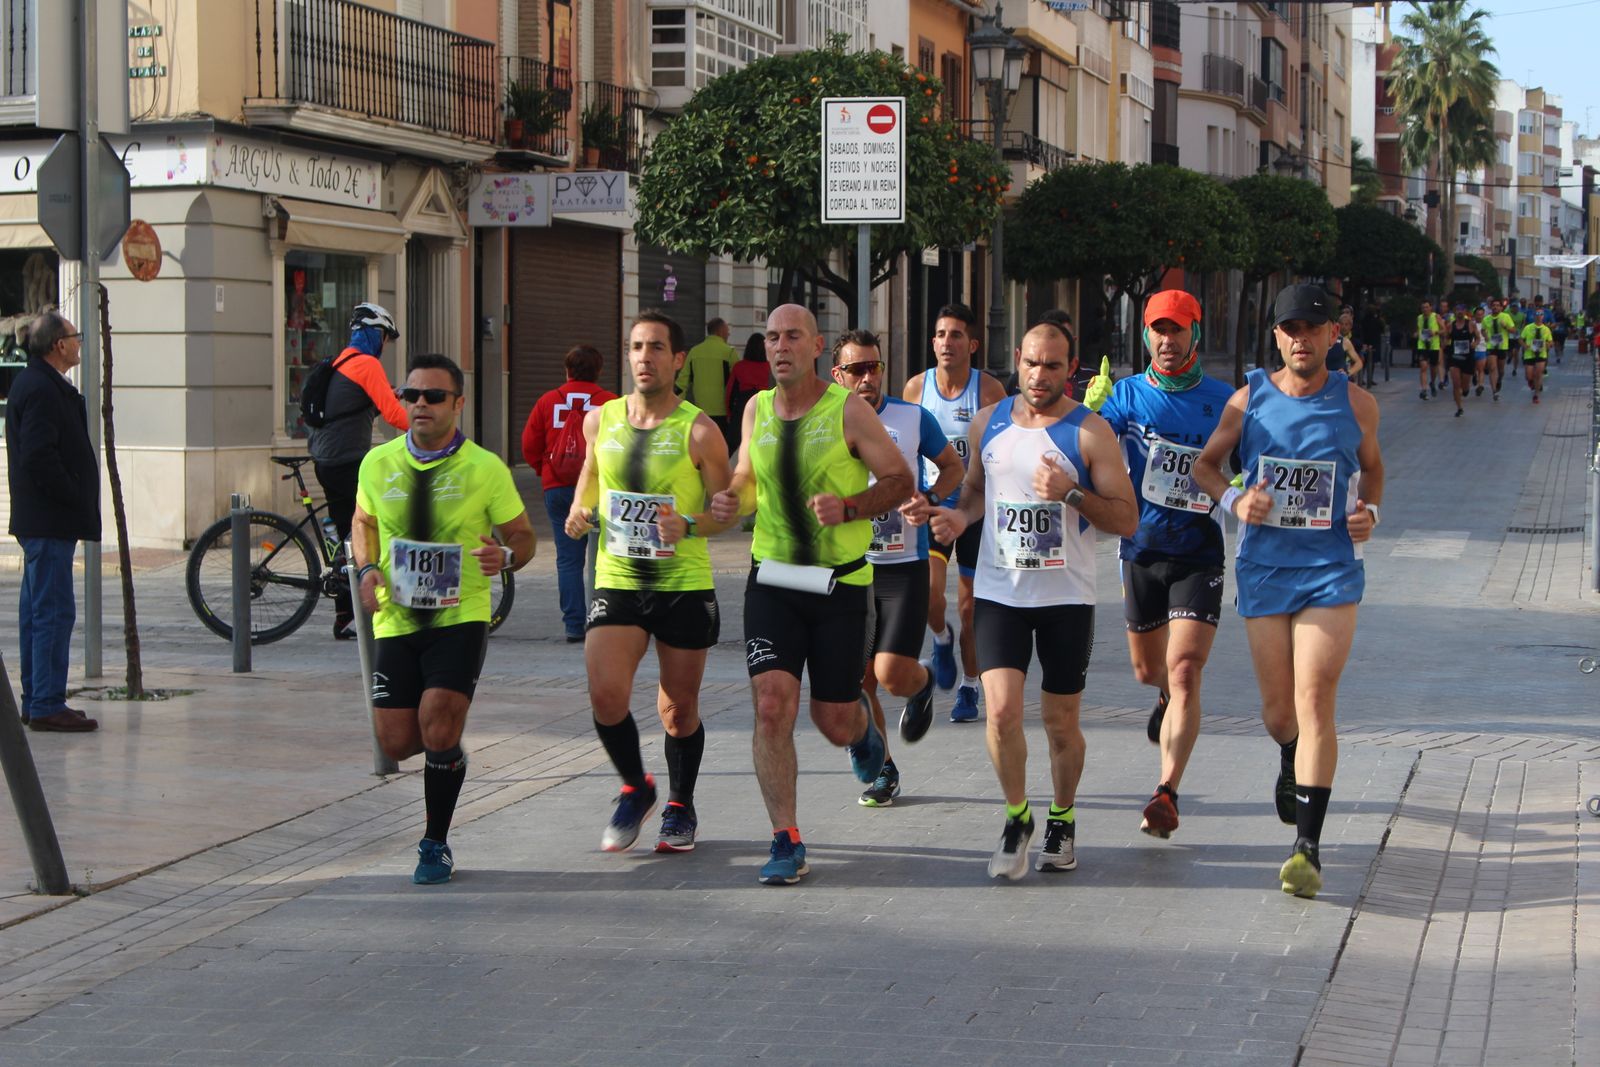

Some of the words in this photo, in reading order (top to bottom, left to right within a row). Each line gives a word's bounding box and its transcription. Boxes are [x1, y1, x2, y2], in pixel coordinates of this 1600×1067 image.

[128, 25, 162, 38] PLAZA
[137, 47, 152, 57] DE
[128, 63, 166, 78] SPAÑA
[288, 159, 300, 186] &
[306, 154, 340, 192] Todo
[343, 165, 361, 199] 2€
[830, 161, 860, 173] FESTIVOS
[863, 161, 868, 173] Y
[871, 161, 896, 173] NOCHES
[830, 179, 838, 191] DE
[838, 179, 861, 191] VERANO
[830, 198, 858, 210] CORTADA
[861, 198, 868, 210] AL
[871, 198, 896, 210] TRAFICO
[1162, 450, 1203, 475] 36
[1274, 466, 1320, 492] 242
[620, 498, 661, 524] 222
[1006, 508, 1050, 534] 296
[408, 548, 445, 574] 181
